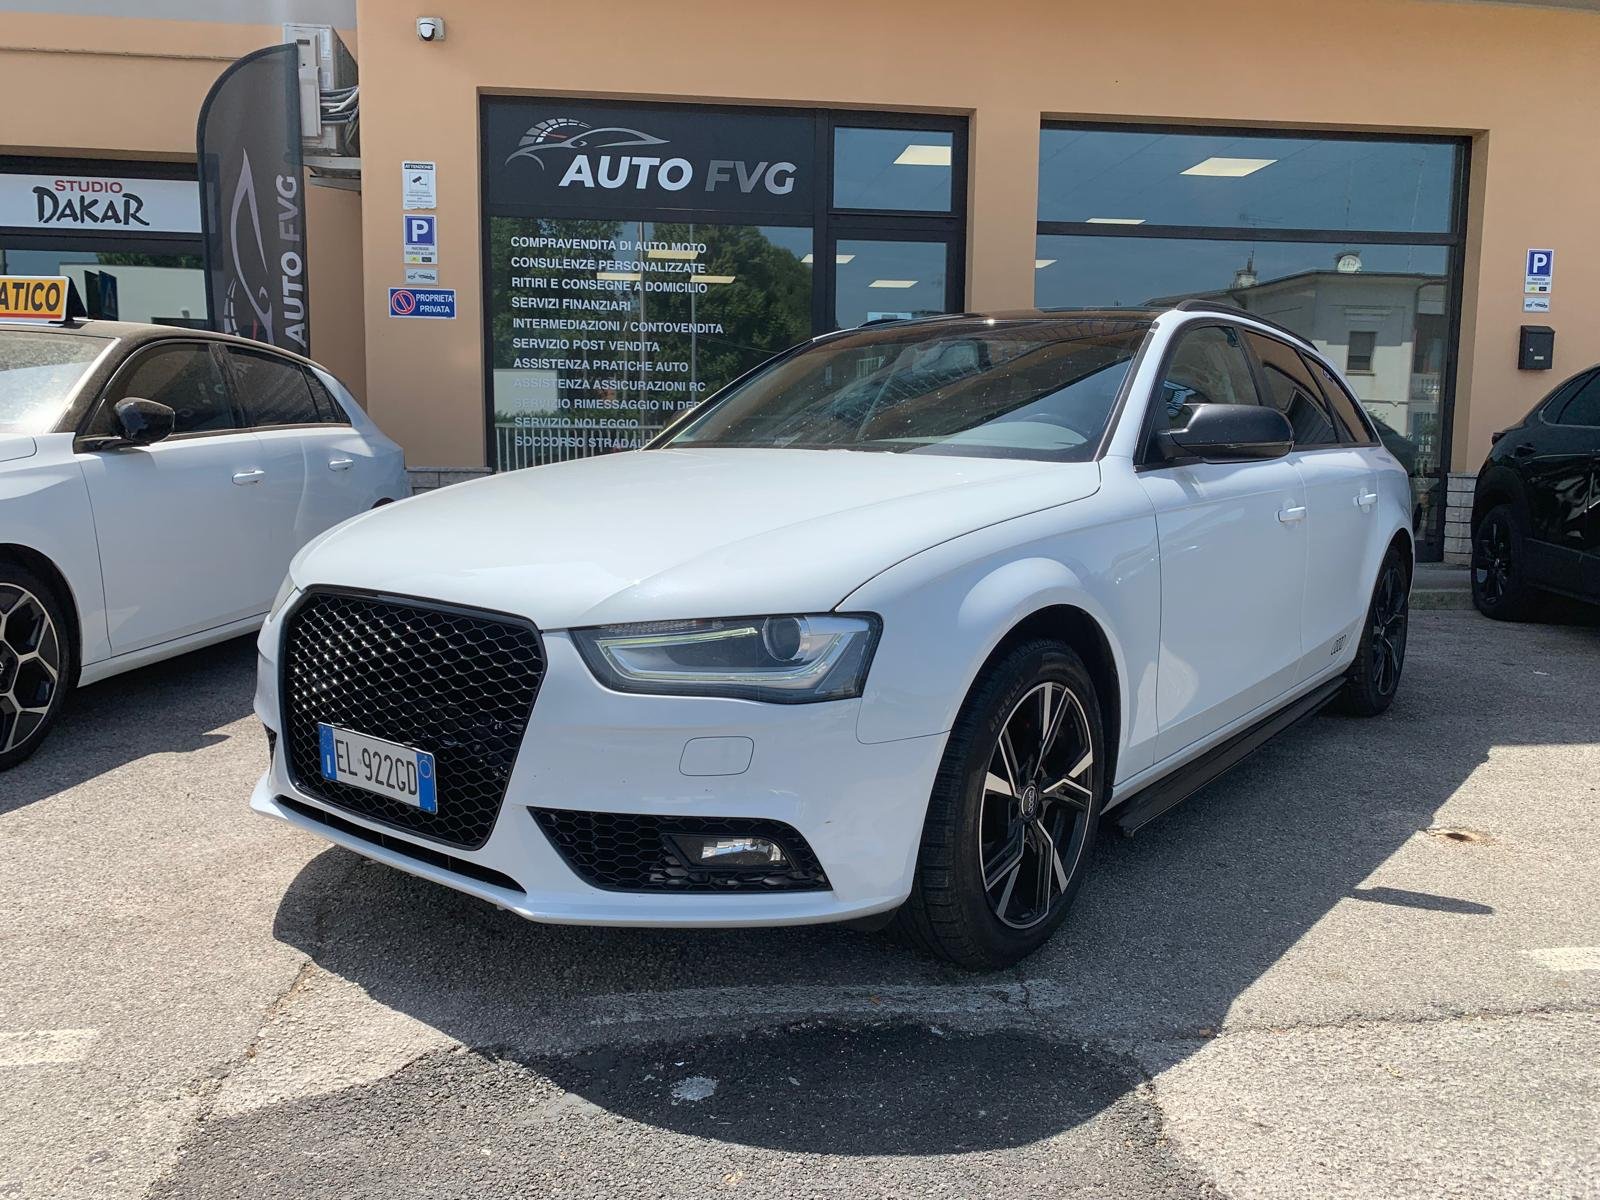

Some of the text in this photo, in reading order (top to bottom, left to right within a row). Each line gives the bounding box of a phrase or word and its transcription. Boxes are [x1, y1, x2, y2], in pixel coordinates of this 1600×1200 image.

[559, 154, 797, 195] AUTO FVG
[54, 179, 123, 194] STUDIO
[32, 186, 150, 226] DAKAR
[411, 219, 429, 242] P
[511, 236, 707, 254] COMPRAVENDITA DI AUTO MOTO
[275, 174, 307, 348] AUTO FVG
[511, 257, 706, 273] CONSULENZE PERSONALIZZATE
[1533, 253, 1547, 273] P
[511, 277, 708, 294] RITIRI E CONSEGNE A DOMICILIO
[0, 281, 60, 311] ATICO
[511, 297, 631, 311] SERVIZI FINANZIARI
[420, 305, 450, 313] PRIVATA
[513, 318, 620, 331] INTERMEDIAZIONI
[630, 322, 724, 334] CONTOVENDITA
[512, 338, 660, 352] SERVIZIO POST VENDITA
[513, 358, 689, 372] ASSISTENZA PRATICHE AUTO
[513, 377, 706, 392] ASSISTENZA ASSICURAZIONI RC
[513, 397, 571, 409] SERVIZIO
[574, 399, 659, 411] RIMESSAGGIO
[662, 401, 674, 411] IN
[514, 417, 639, 429] SERVIZIO NOLEGGIO
[515, 436, 586, 448] SOCCORSO
[335, 739, 418, 796] EL 922GD
